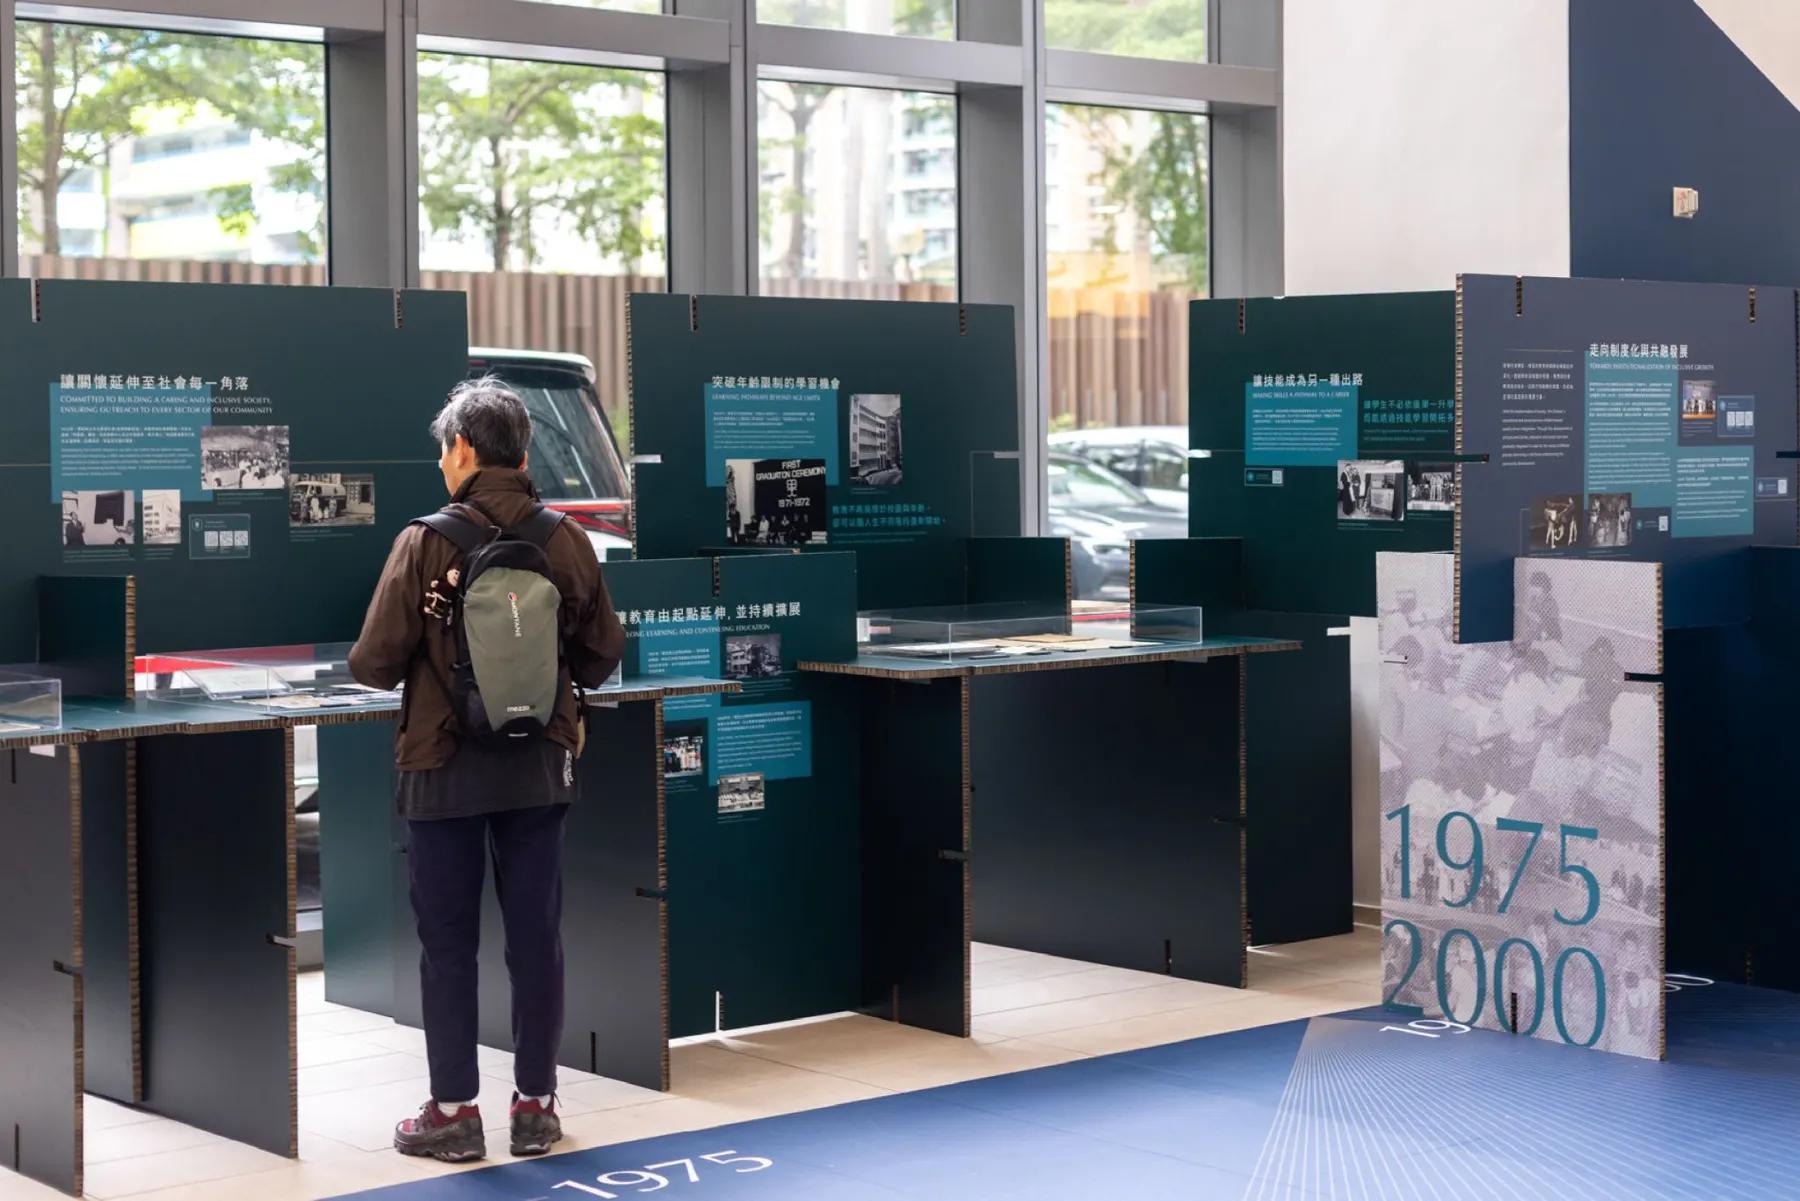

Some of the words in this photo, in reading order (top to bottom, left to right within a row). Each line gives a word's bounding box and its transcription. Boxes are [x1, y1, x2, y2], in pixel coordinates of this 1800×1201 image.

[1589, 342, 1688, 358] 走向制度化與共融發展
[60, 374, 248, 390] 讓關懷延伸至社會每一角落
[712, 376, 840, 390] 突破年齡限制的學習機會
[1252, 373, 1363, 388] 讓技能成為另一種出路
[60, 395, 104, 403] COMMITTED
[161, 396, 188, 404] CARING
[189, 396, 205, 404] AND
[207, 396, 241, 404] INCLUSIVE
[782, 460, 802, 470] FIRST
[778, 498, 810, 508] 1971-1972
[626, 630, 645, 638] LONG
[646, 629, 678, 637] LEARNING
[736, 624, 770, 632] EDUCATION
[1386, 803, 1600, 926] 1975
[1381, 918, 1606, 1047] 2000
[1379, 1019, 1472, 1038] 19
[551, 1150, 773, 1199] 1975
